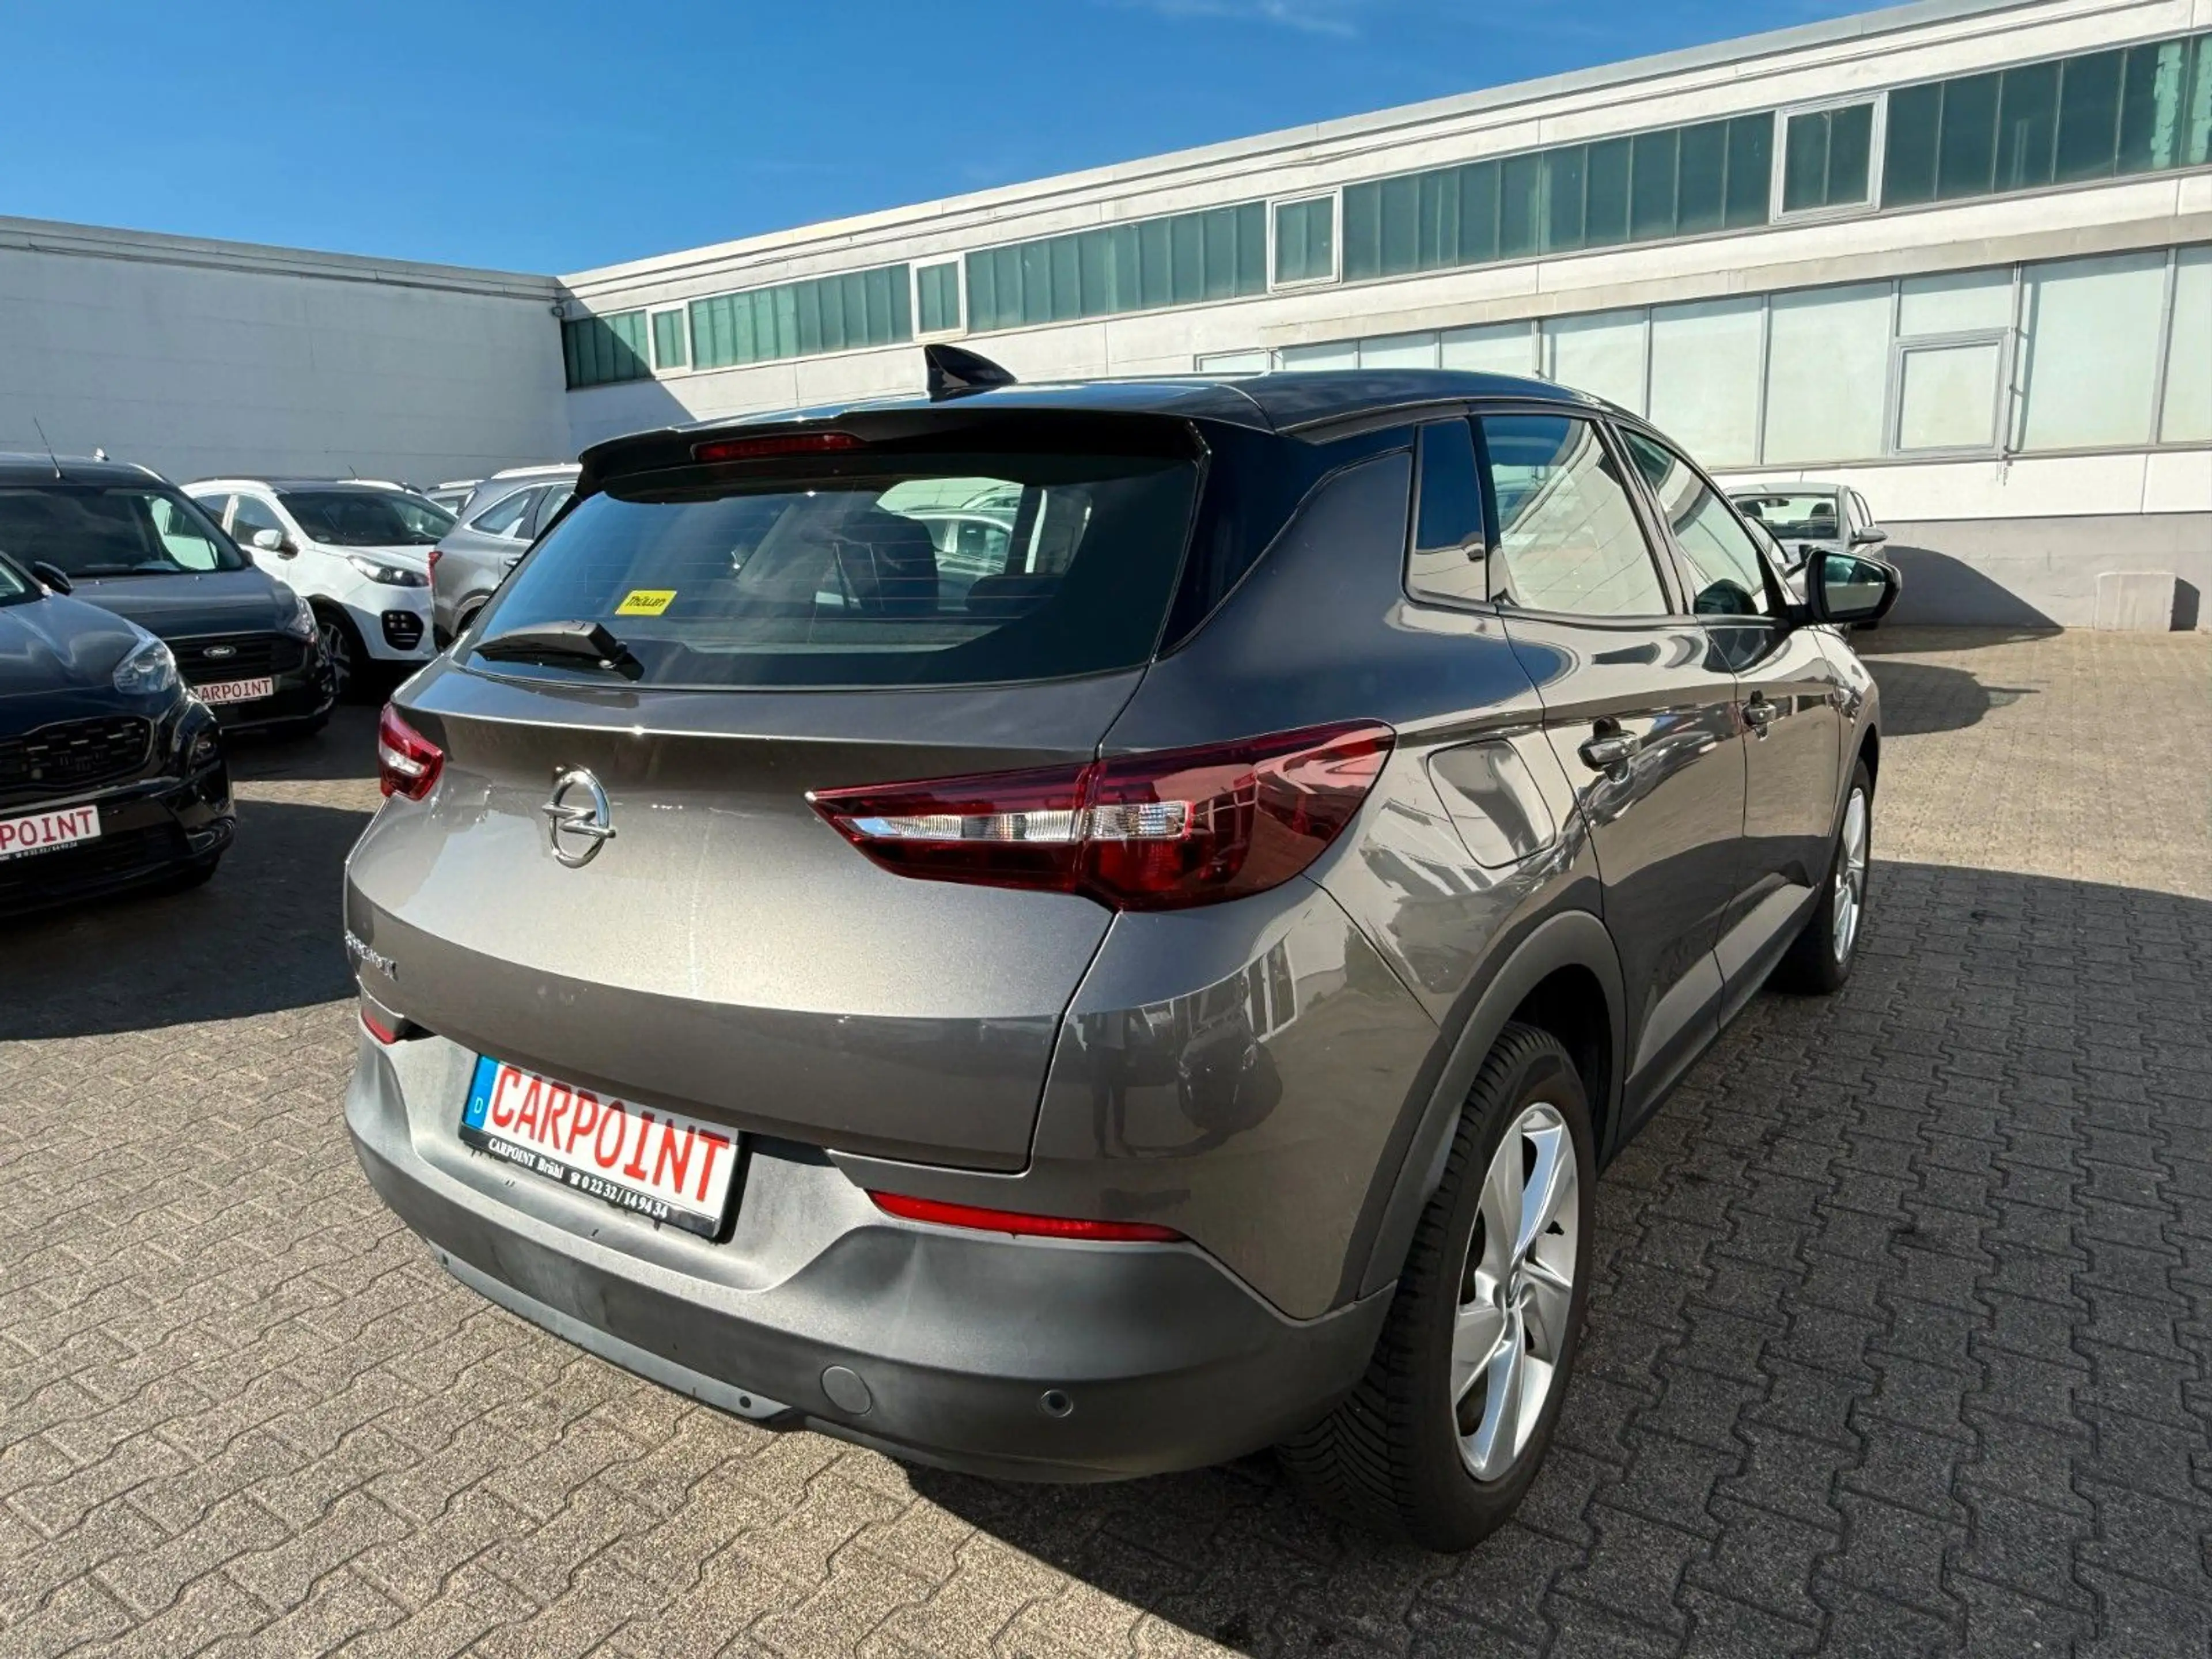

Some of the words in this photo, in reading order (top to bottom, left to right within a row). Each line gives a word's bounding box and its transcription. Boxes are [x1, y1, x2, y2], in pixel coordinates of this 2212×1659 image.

[474, 1097, 483, 1114] D
[491, 1065, 730, 1202] CARPOINT
[488, 1138, 536, 1167] CARPOINT
